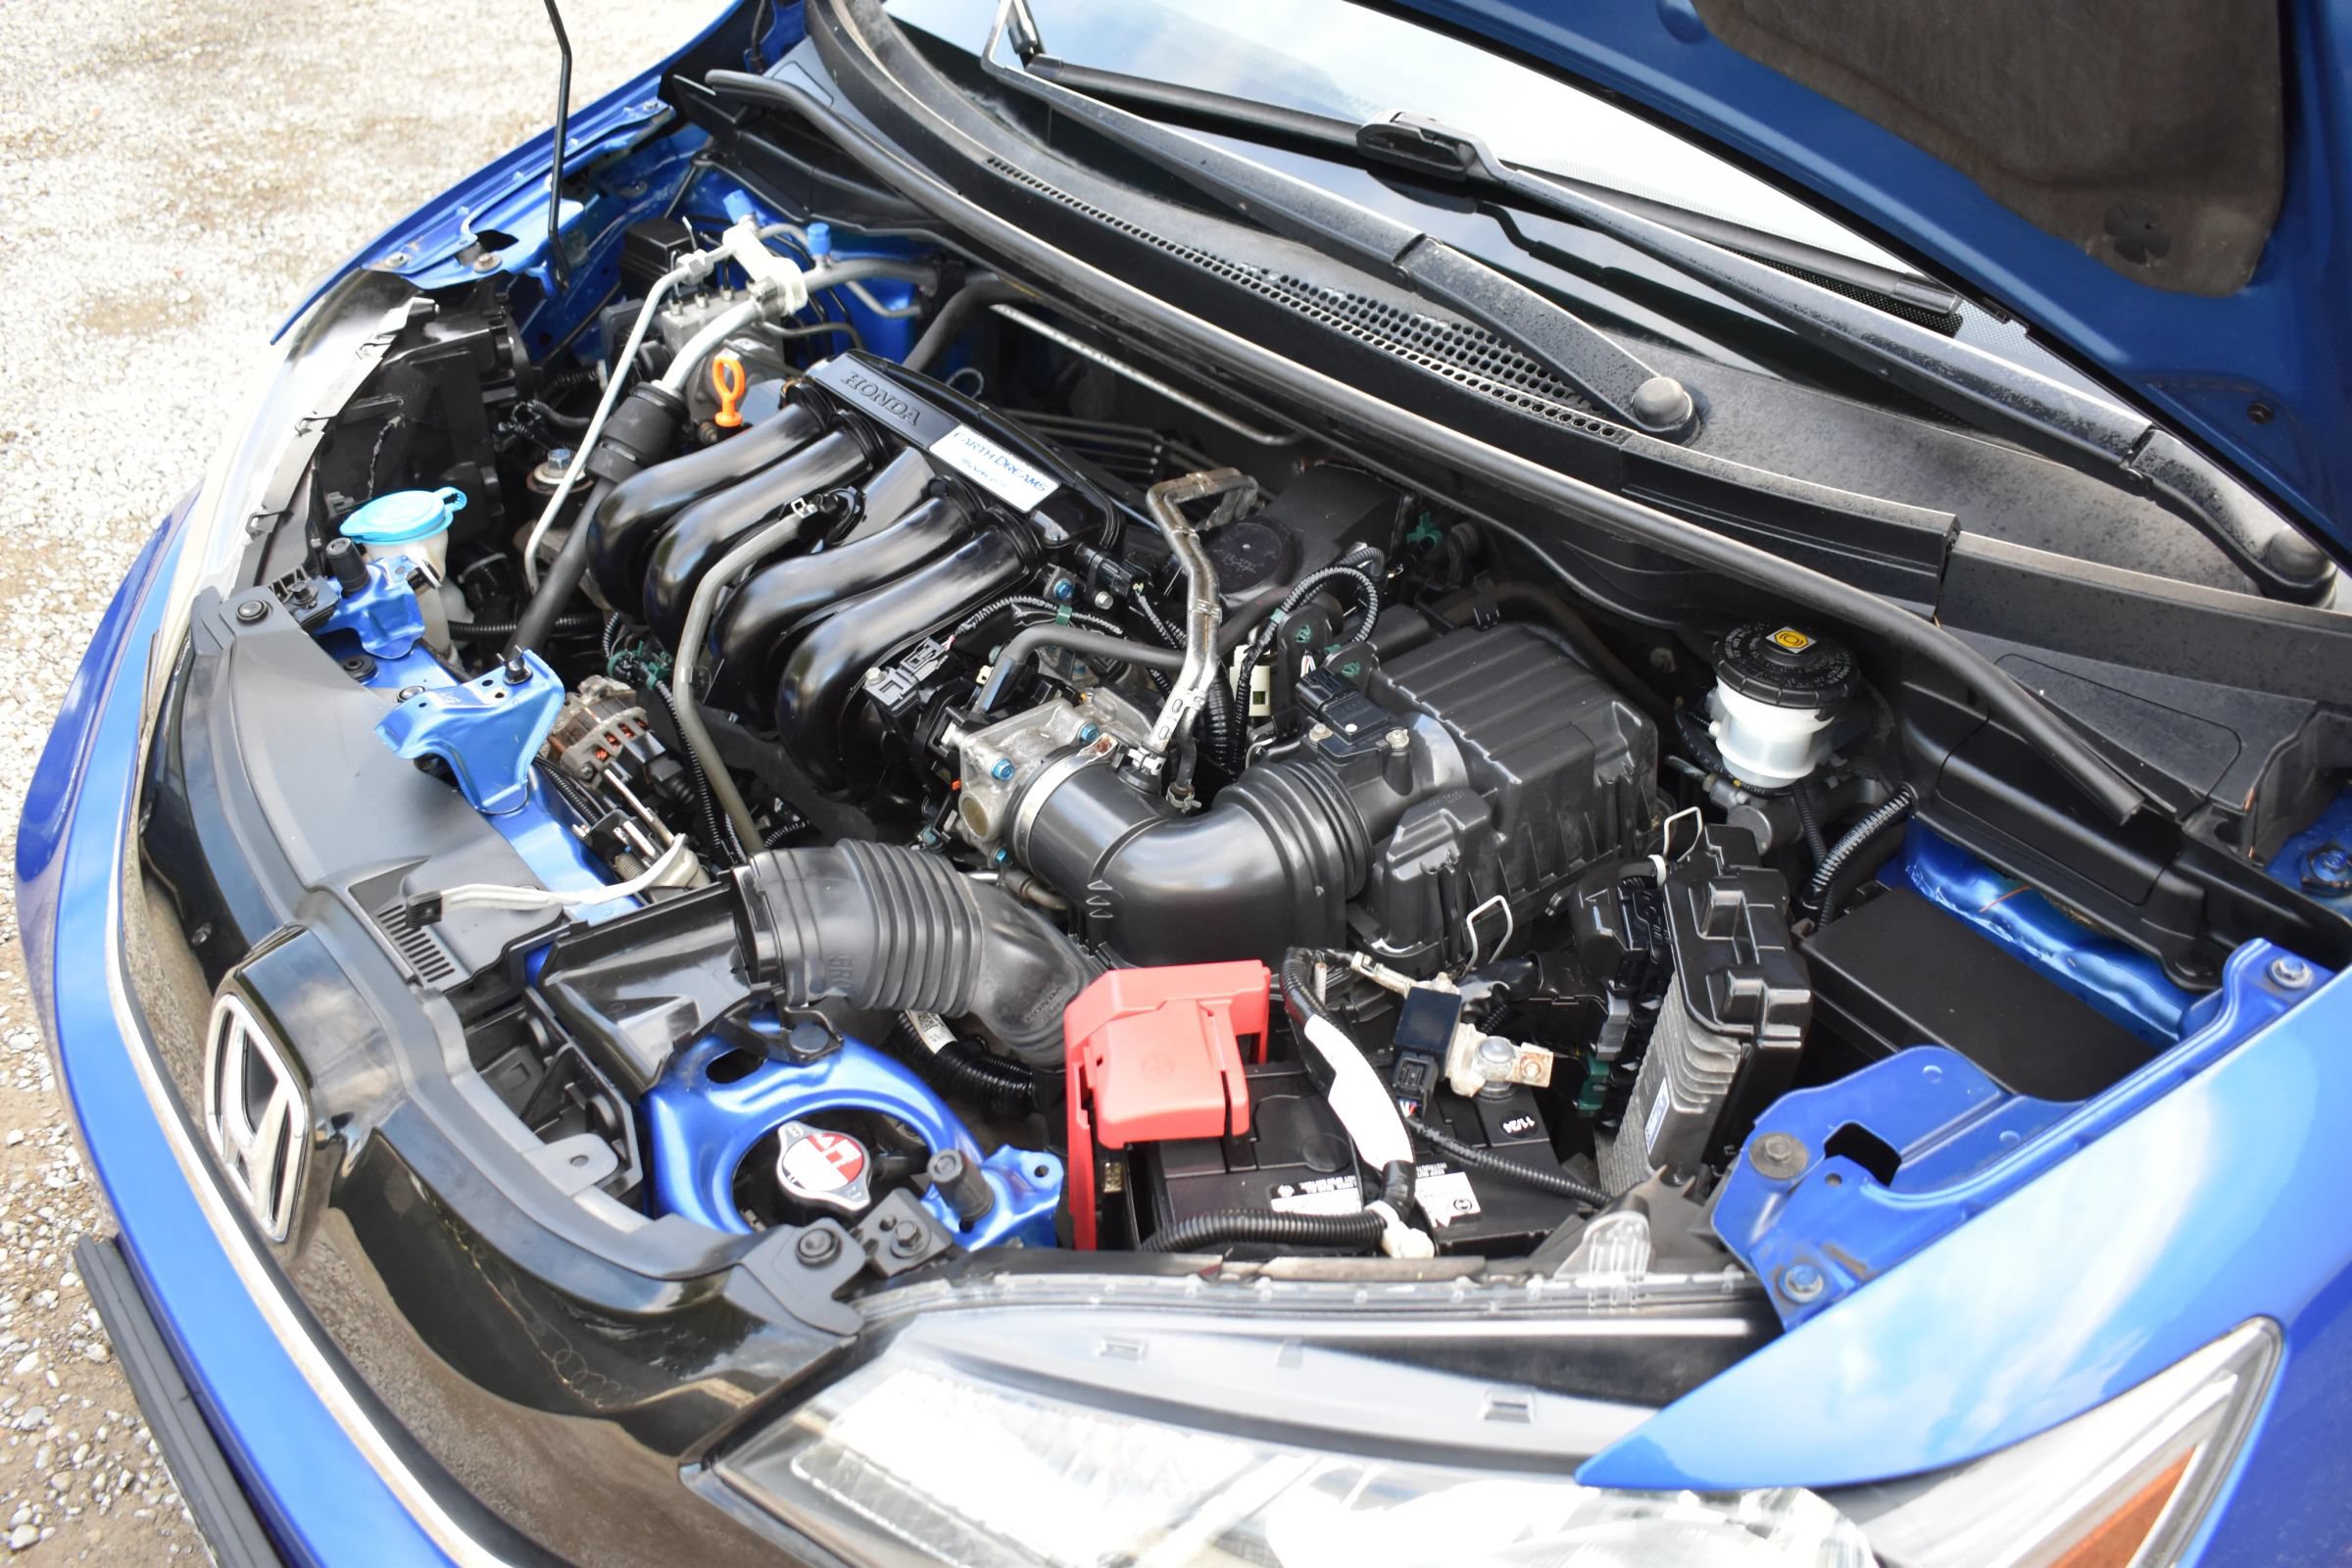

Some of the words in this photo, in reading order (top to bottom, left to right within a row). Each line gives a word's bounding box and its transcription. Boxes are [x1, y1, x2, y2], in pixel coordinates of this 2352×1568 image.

[840, 370, 922, 427] HONDA
[954, 431, 996, 460] EARTH
[995, 455, 1049, 492] DREAMS
